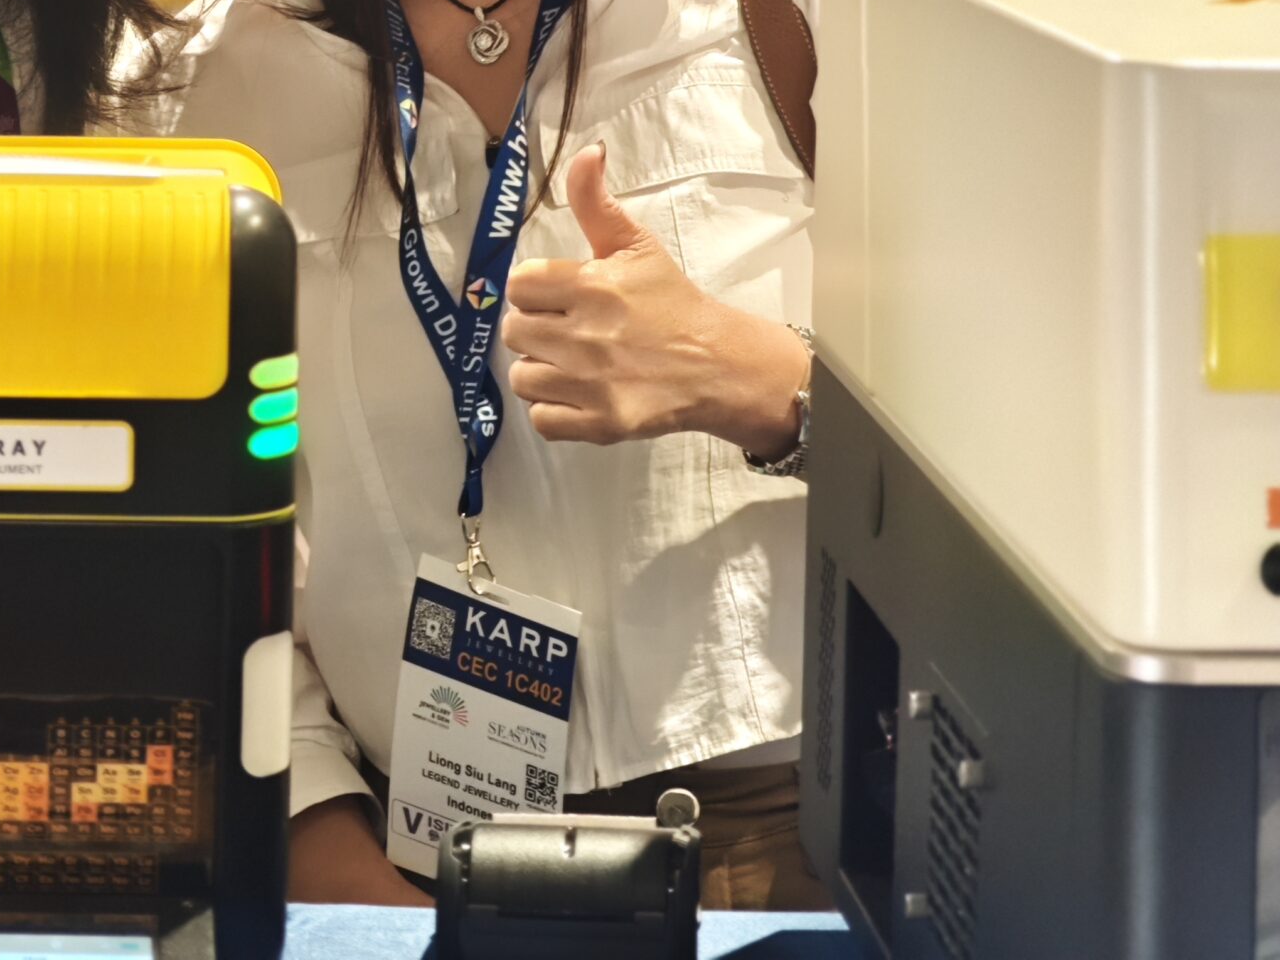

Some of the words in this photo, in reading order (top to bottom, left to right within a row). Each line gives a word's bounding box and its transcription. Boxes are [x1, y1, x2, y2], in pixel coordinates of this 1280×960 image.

[404, 228, 440, 314] Grown
[462, 317, 492, 373] Star
[465, 606, 568, 662] KARP
[457, 651, 498, 682] CEC
[505, 670, 563, 707] 1C402
[422, 768, 461, 790] LEGEND
[462, 784, 520, 811] JEWELLERY
[428, 750, 462, 775] Liong
[464, 765, 484, 782] Siu
[487, 772, 517, 796] Lang
[447, 795, 493, 822] Indones
